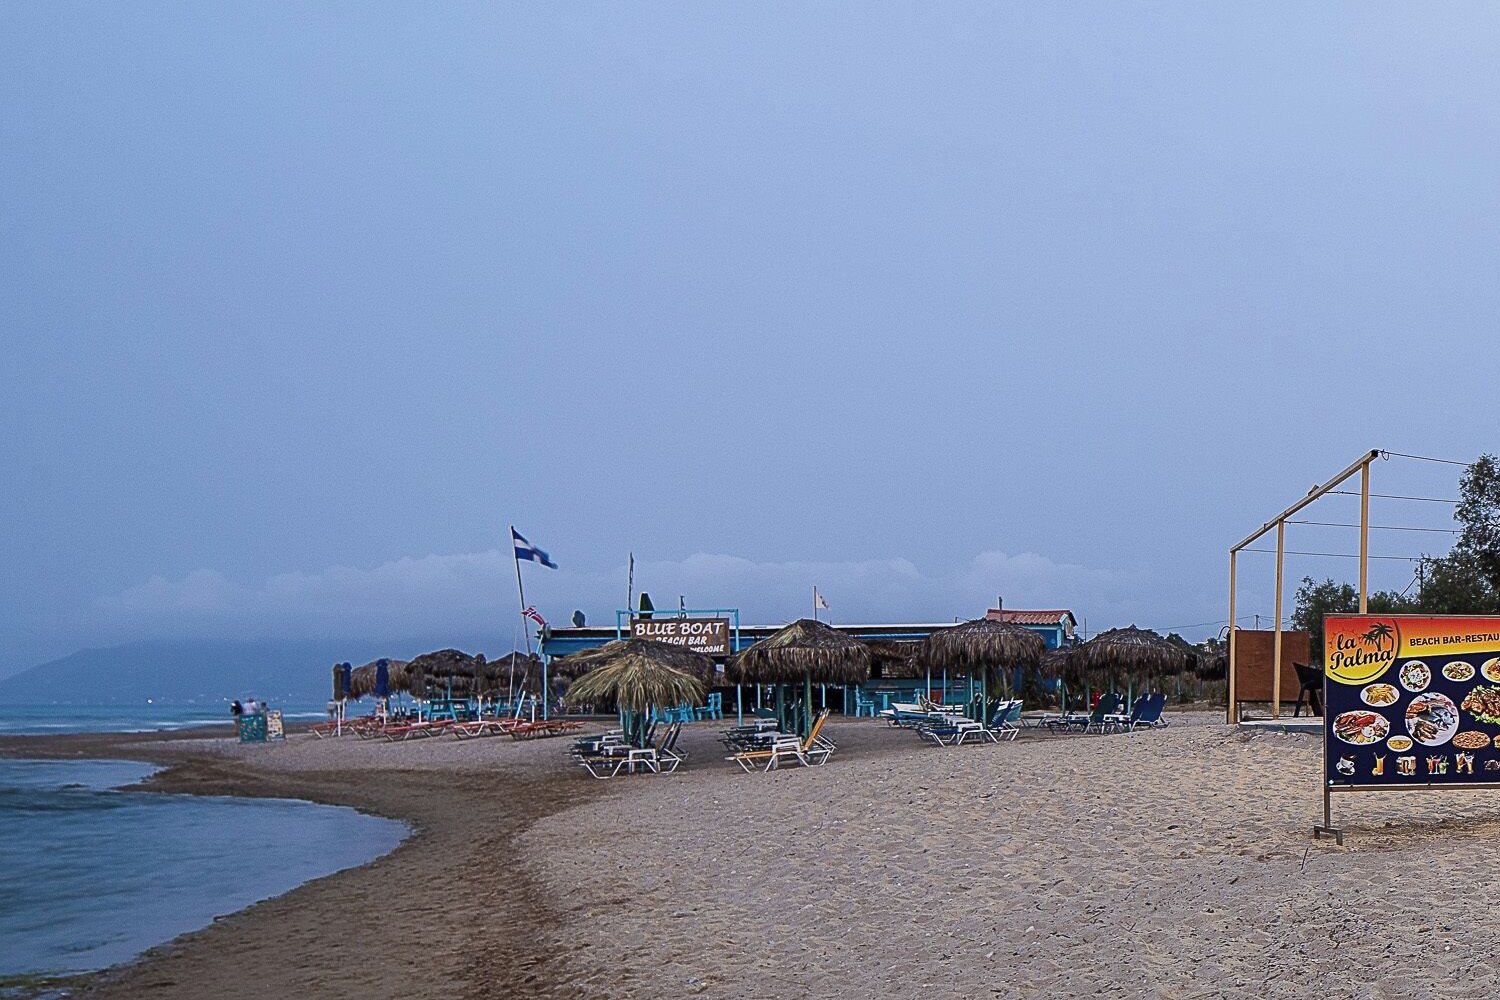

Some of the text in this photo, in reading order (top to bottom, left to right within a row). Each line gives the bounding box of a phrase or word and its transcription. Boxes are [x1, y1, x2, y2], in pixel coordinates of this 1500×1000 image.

[635, 622, 724, 636] BLUE BOAT
[688, 636, 708, 645] BAR
[1337, 634, 1357, 651] la
[1410, 637, 1440, 646] BEACH
[1330, 649, 1393, 670] Palma
